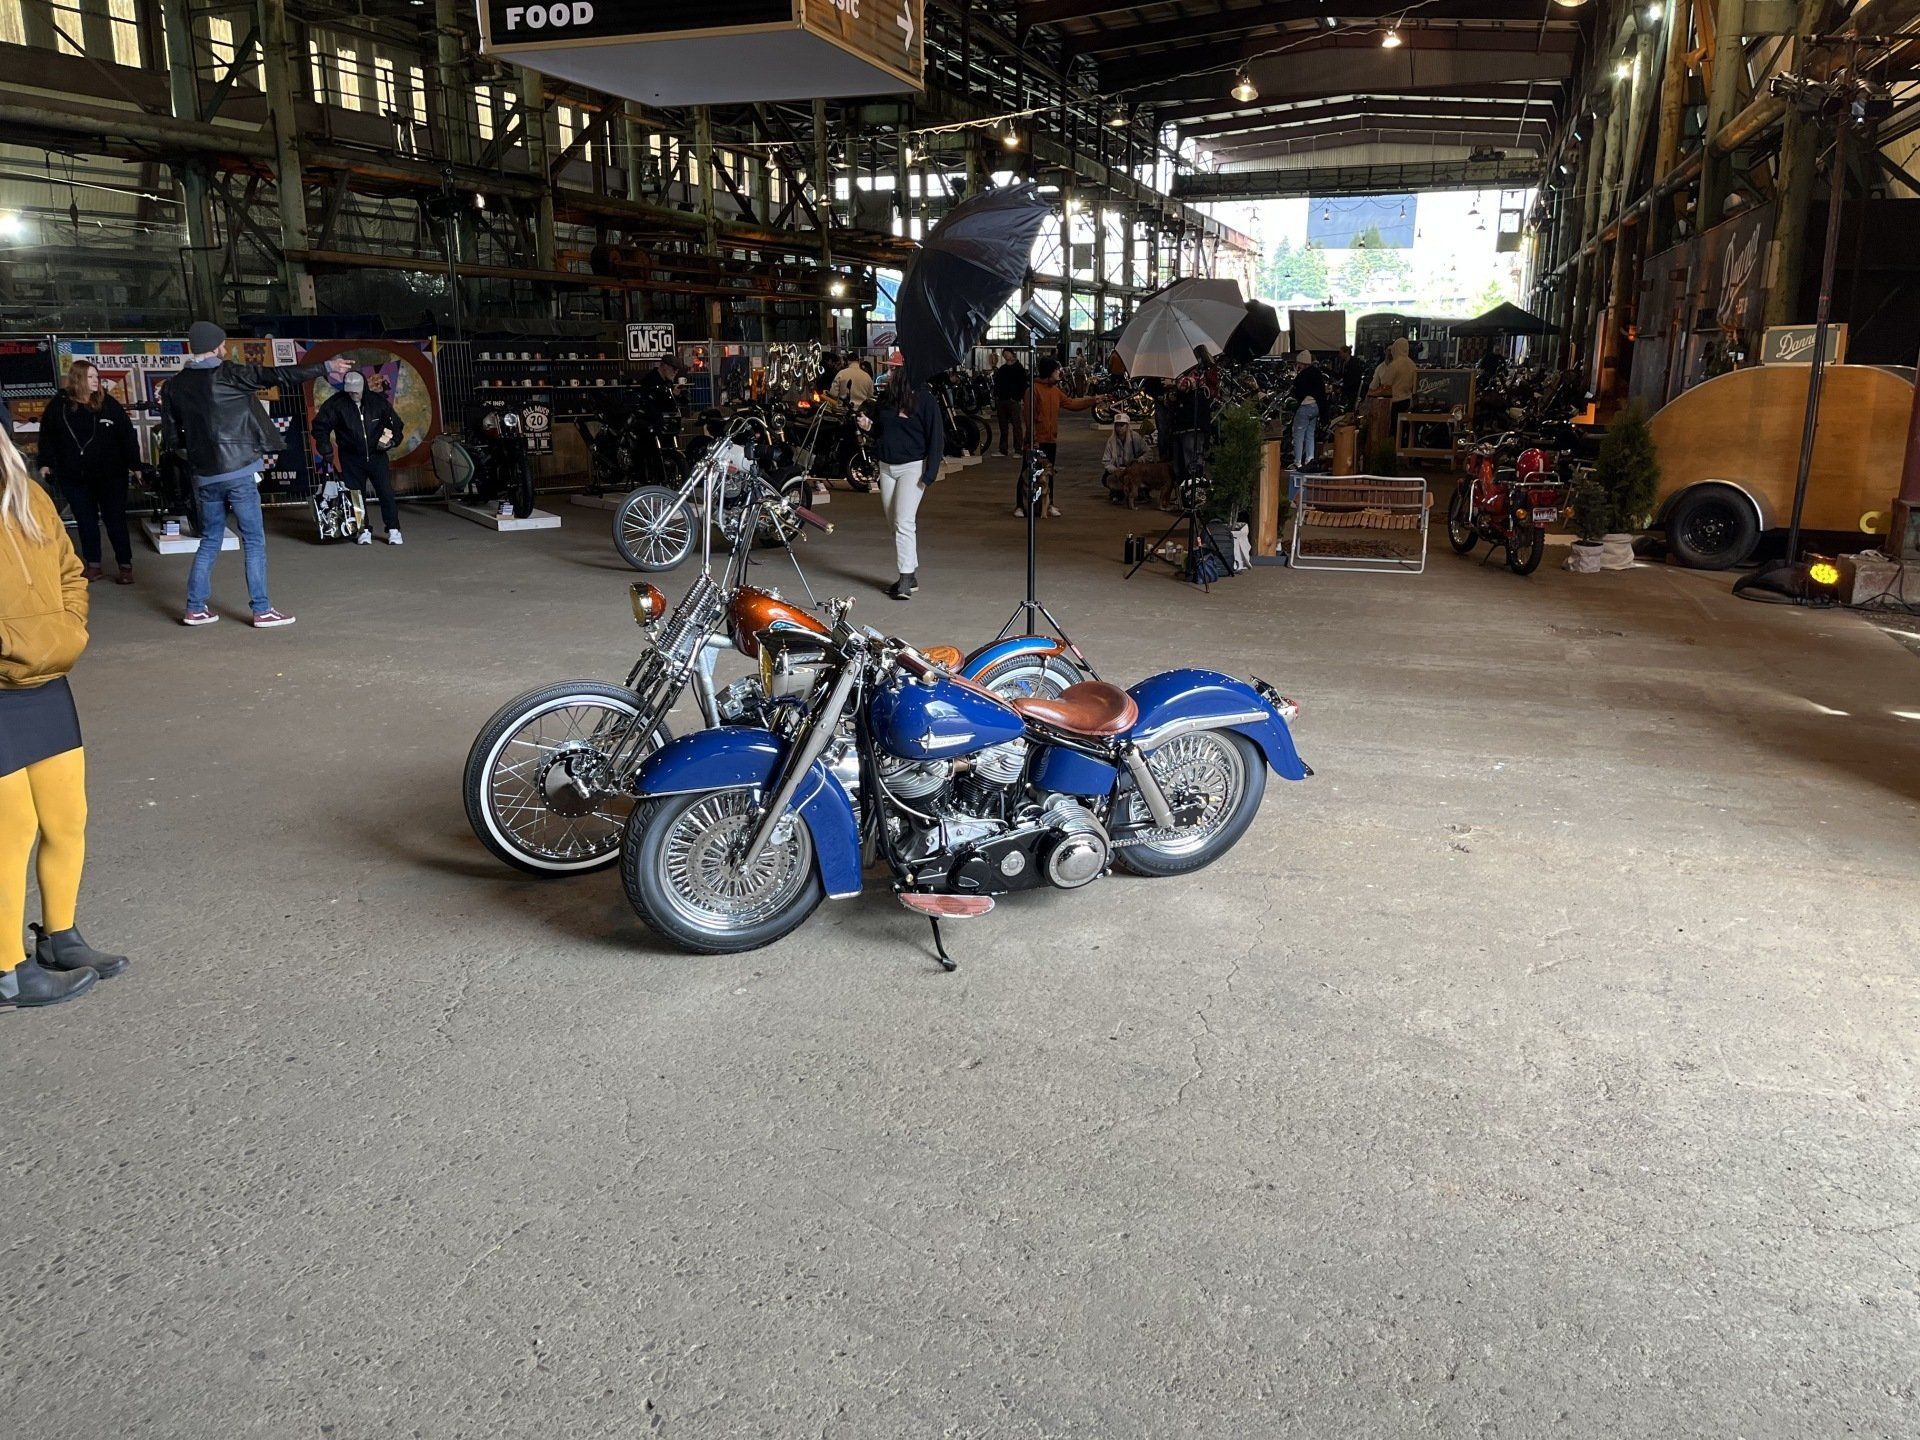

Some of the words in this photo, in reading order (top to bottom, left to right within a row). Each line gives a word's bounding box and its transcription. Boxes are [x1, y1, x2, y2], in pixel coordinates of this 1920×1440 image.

[506, 2, 594, 30] FOOD
[1775, 332, 1816, 360] Danne
[86, 355, 100, 365] THE
[102, 355, 116, 364] LIFE
[119, 355, 138, 364] CYCLE
[140, 356, 149, 364] OF
[153, 356, 158, 364] A
[160, 356, 181, 364] MOPED
[522, 406, 534, 418] ALL
[530, 415, 543, 426] 20
[271, 471, 297, 480] SHOW
